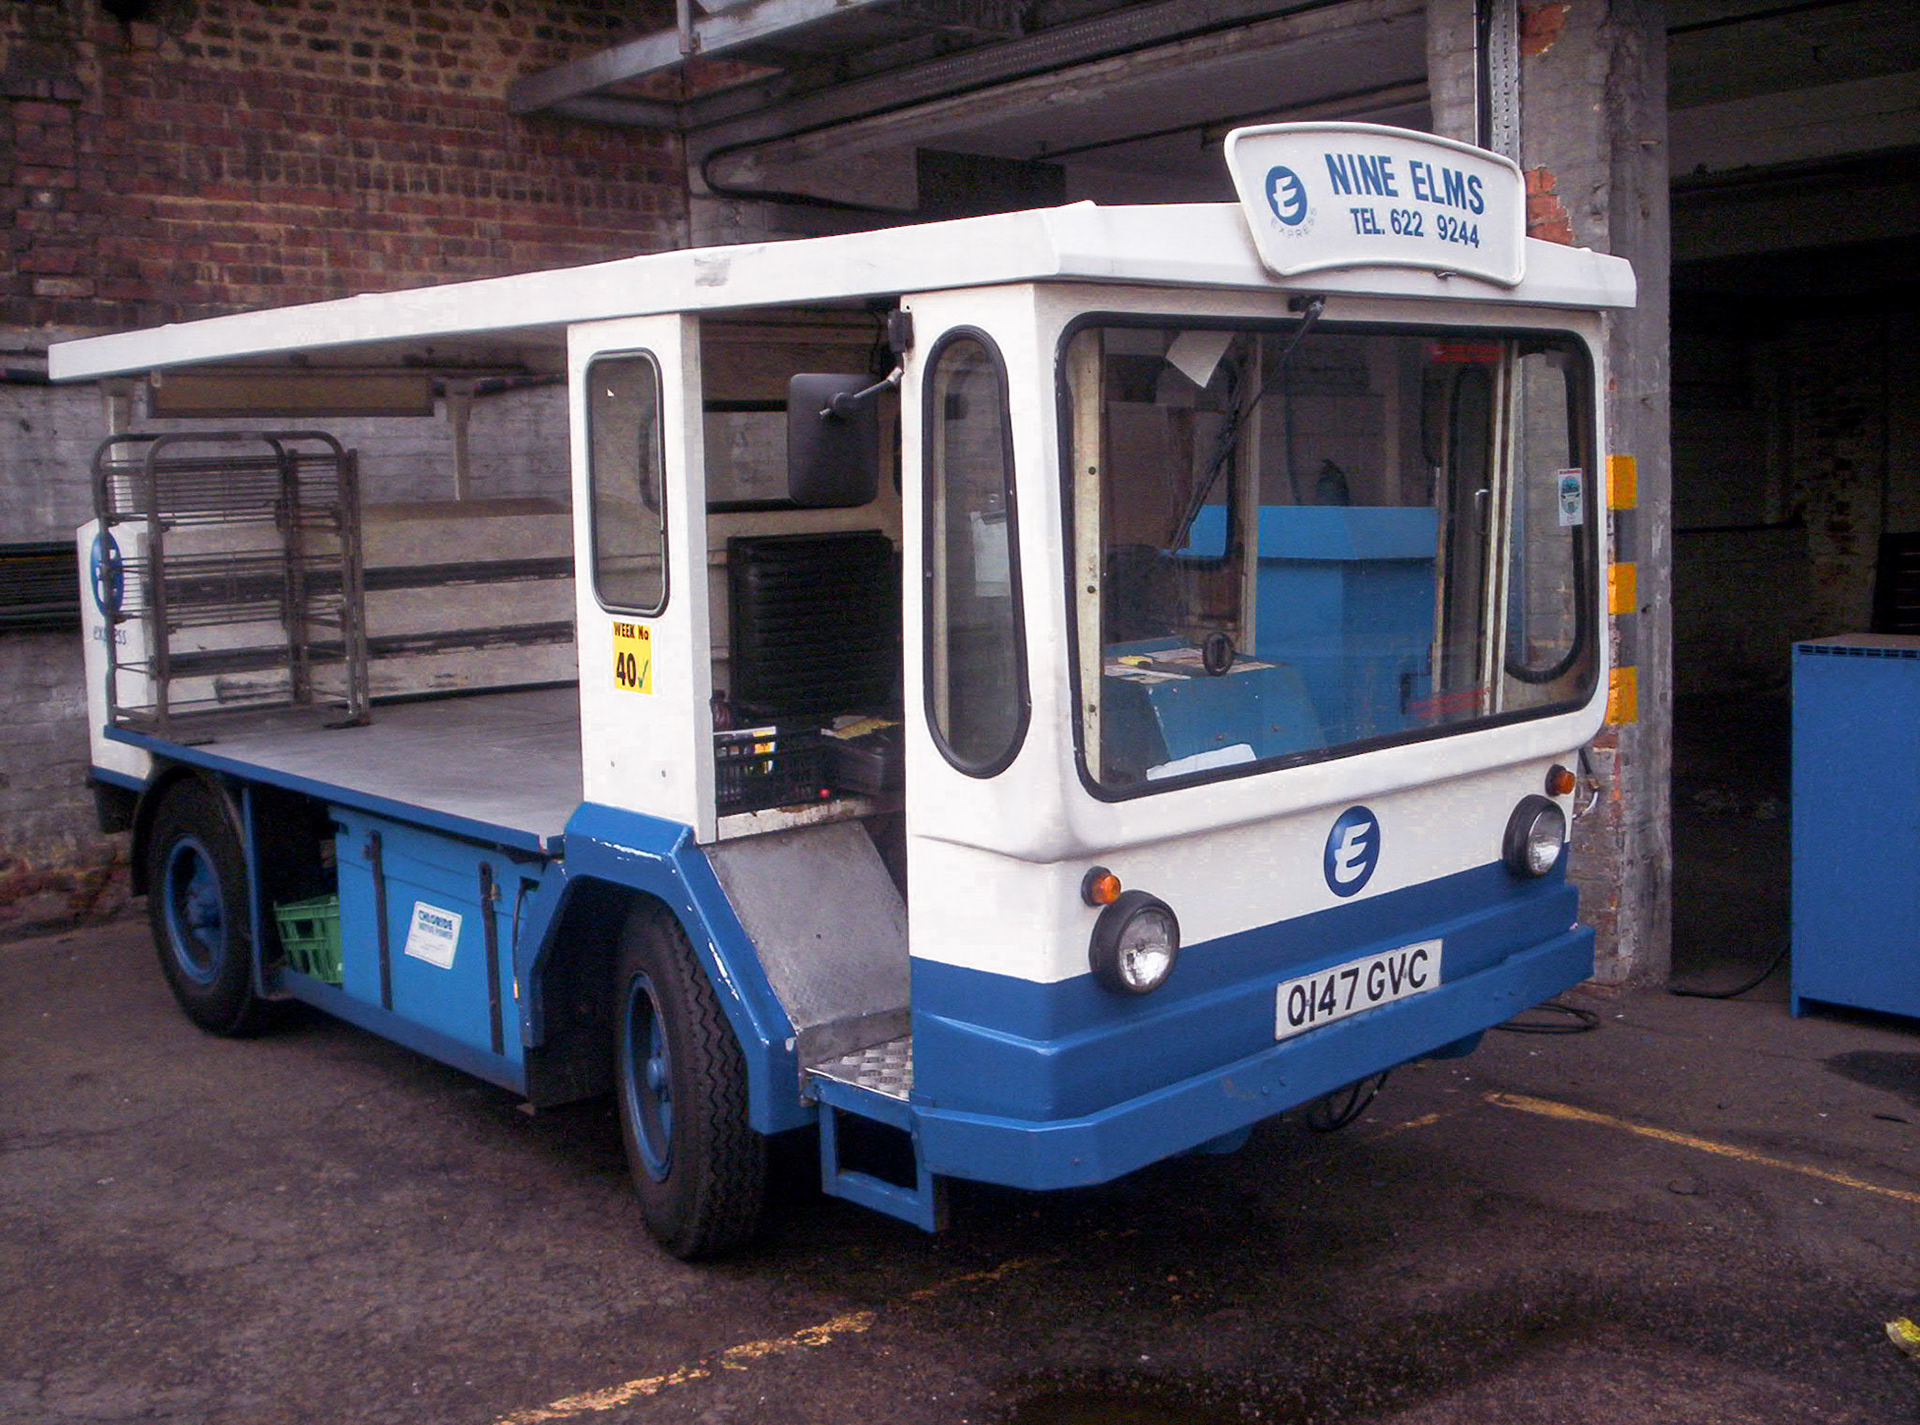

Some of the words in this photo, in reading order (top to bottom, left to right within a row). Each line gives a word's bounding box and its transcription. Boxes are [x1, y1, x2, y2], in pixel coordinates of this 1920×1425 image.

[1325, 153, 1399, 198] NINE
[1409, 159, 1484, 215] ELMS
[1350, 207, 1385, 235] TEL.
[1390, 208, 1424, 237] 622
[1437, 214, 1479, 248] 9244
[613, 621, 635, 639] WEEK
[616, 652, 636, 688] 40
[1287, 967, 1360, 1027] Q147
[1366, 948, 1428, 1002] GVC
